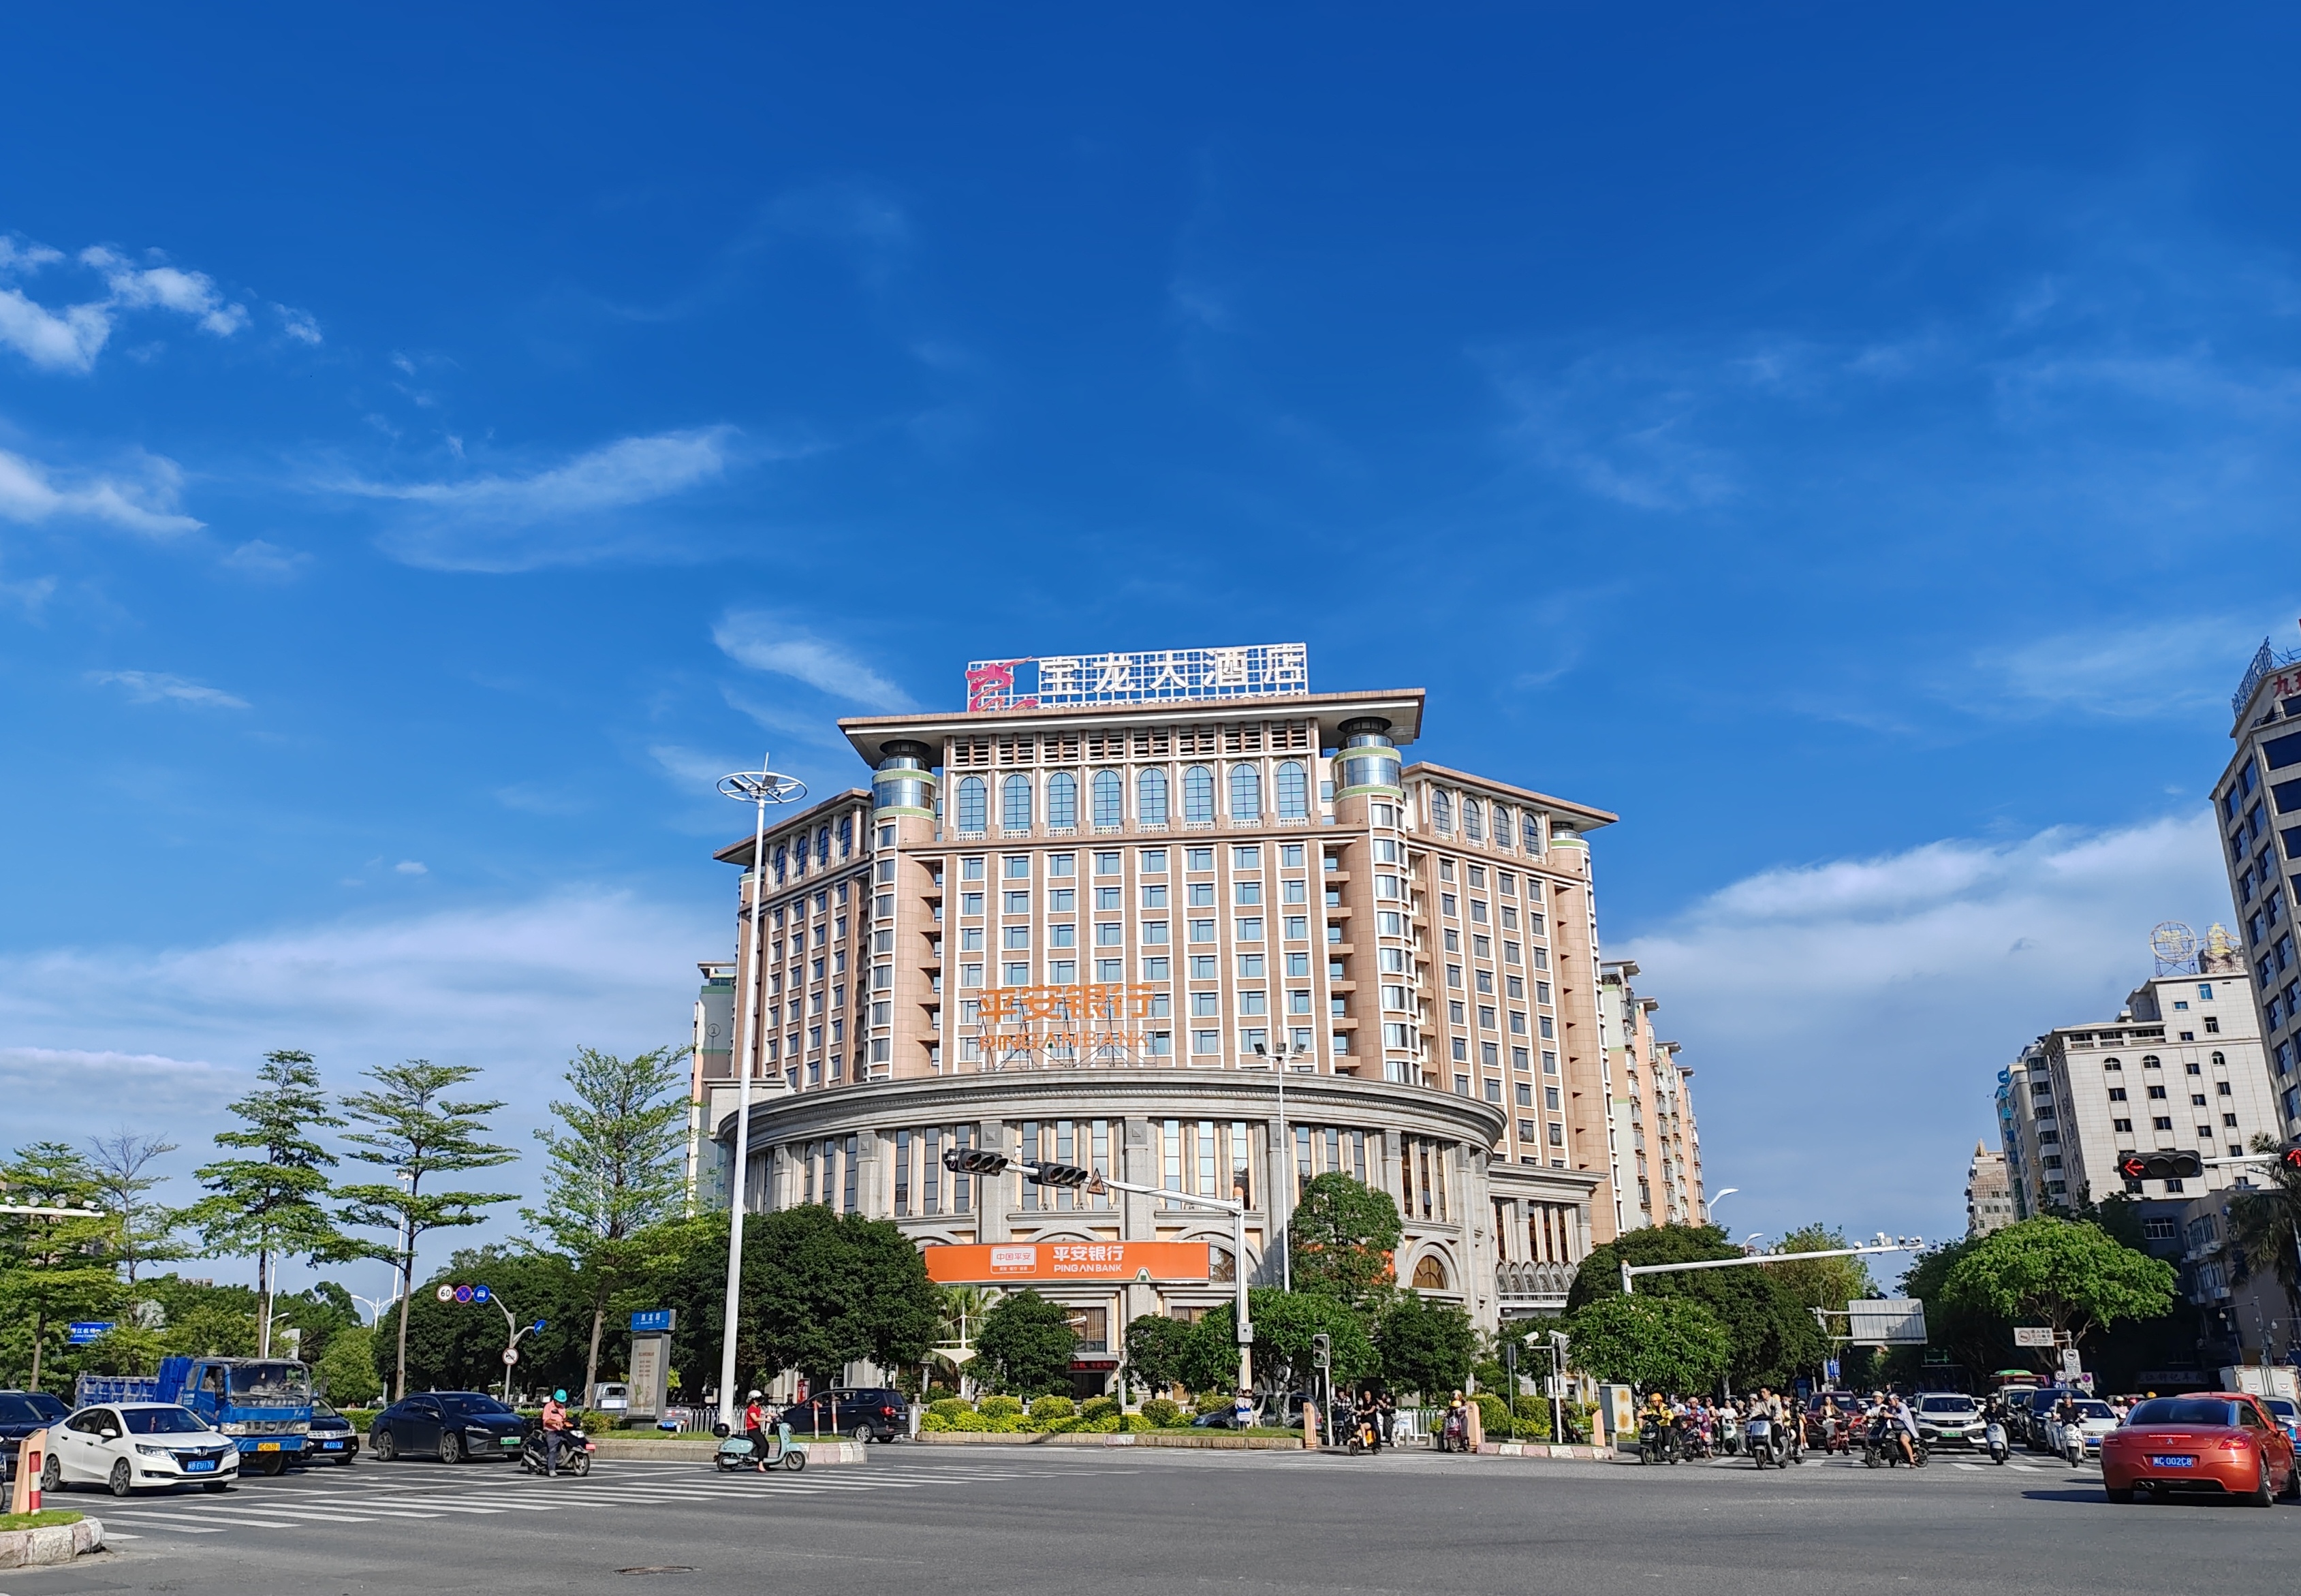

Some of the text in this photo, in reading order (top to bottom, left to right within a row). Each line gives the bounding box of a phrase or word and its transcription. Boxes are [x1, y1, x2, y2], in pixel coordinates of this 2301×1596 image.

[1039, 644, 1306, 697] 宝龙大酒店
[978, 984, 1155, 1023] 平安银行
[1083, 1030, 1150, 1047] BANK
[996, 1253, 1032, 1261] 中国平安
[1052, 1245, 1124, 1262] 平安银行
[1095, 1264, 1123, 1272] BANK
[441, 1289, 450, 1297] 60
